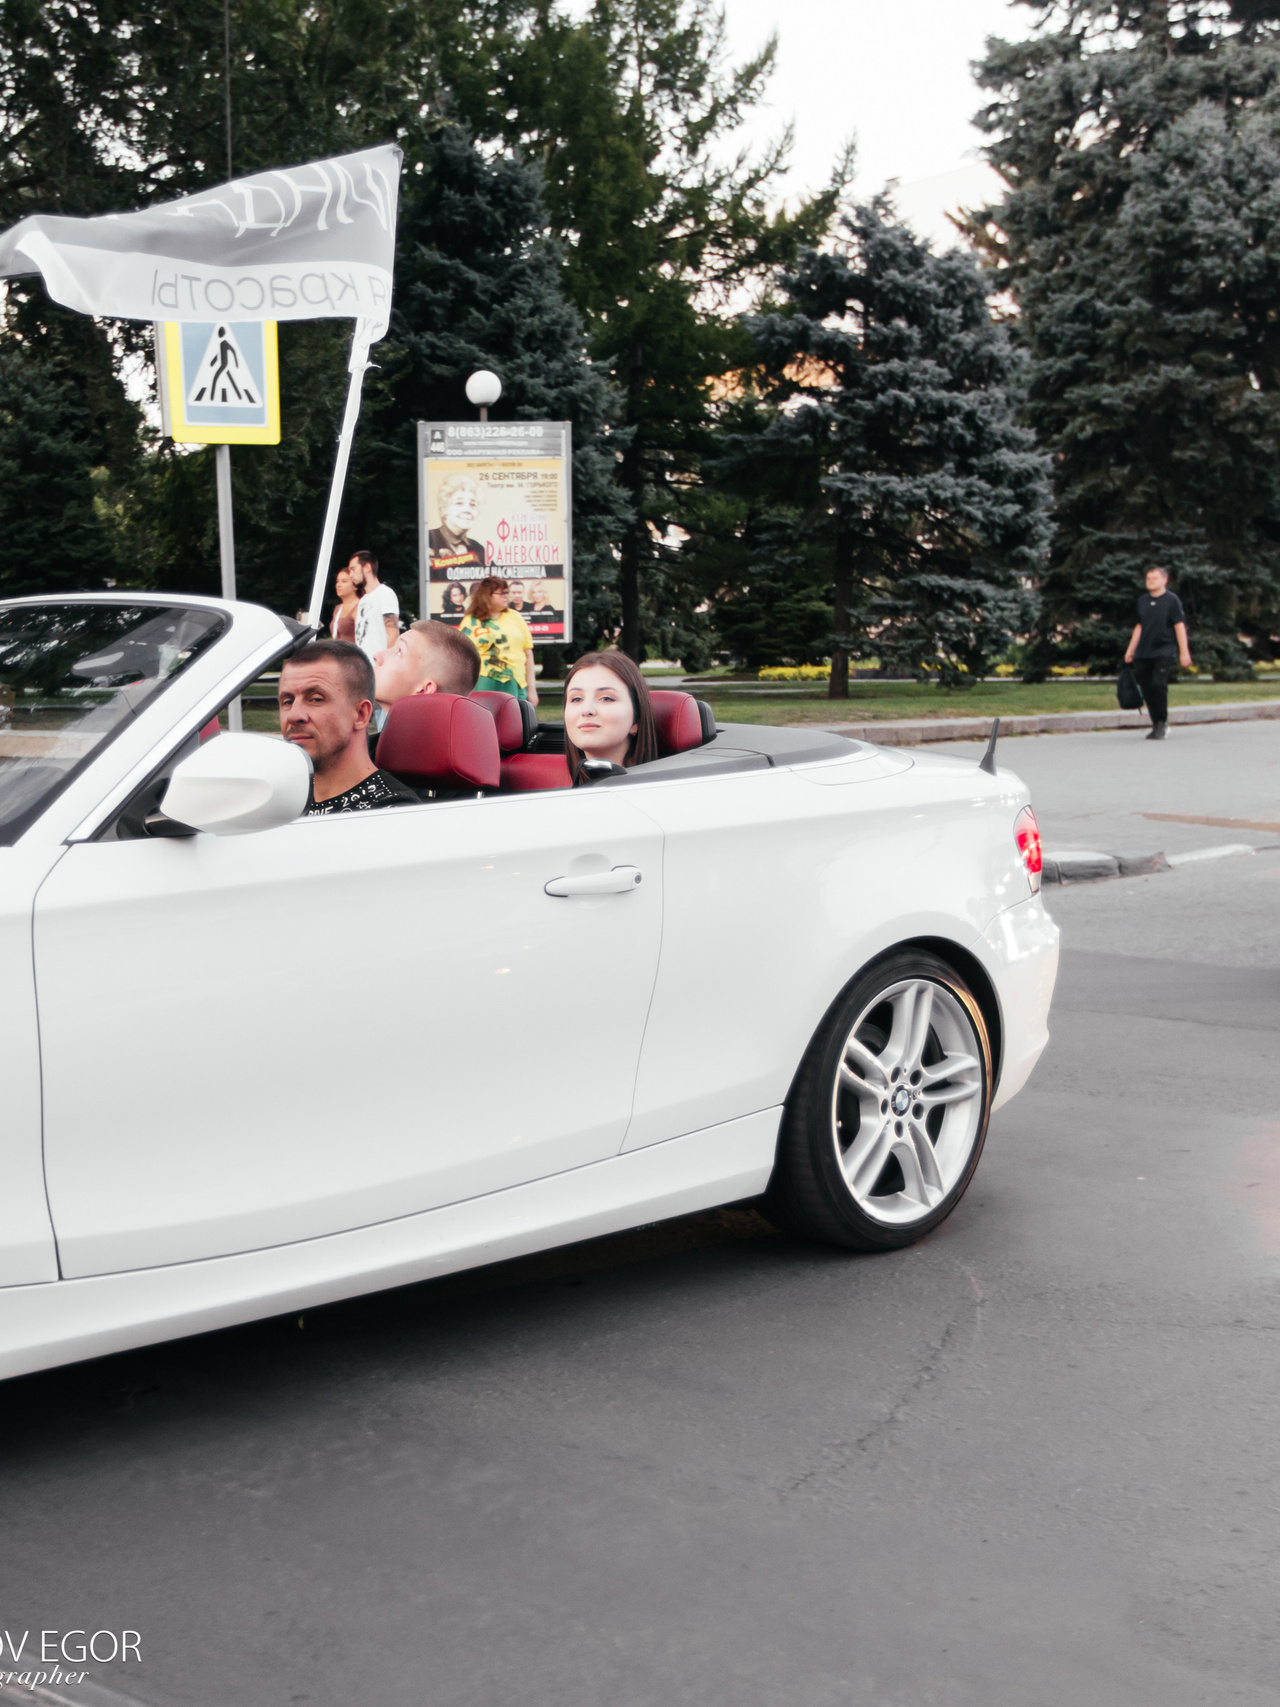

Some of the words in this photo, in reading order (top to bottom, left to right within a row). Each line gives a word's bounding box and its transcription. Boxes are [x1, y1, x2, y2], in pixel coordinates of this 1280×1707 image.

[479, 472, 490, 481] 26
[492, 472, 538, 480] СЕНТЯБРЯ
[496, 518, 548, 542] ФАИНЫ
[486, 540, 560, 565] РАНЕВСКОЙ
